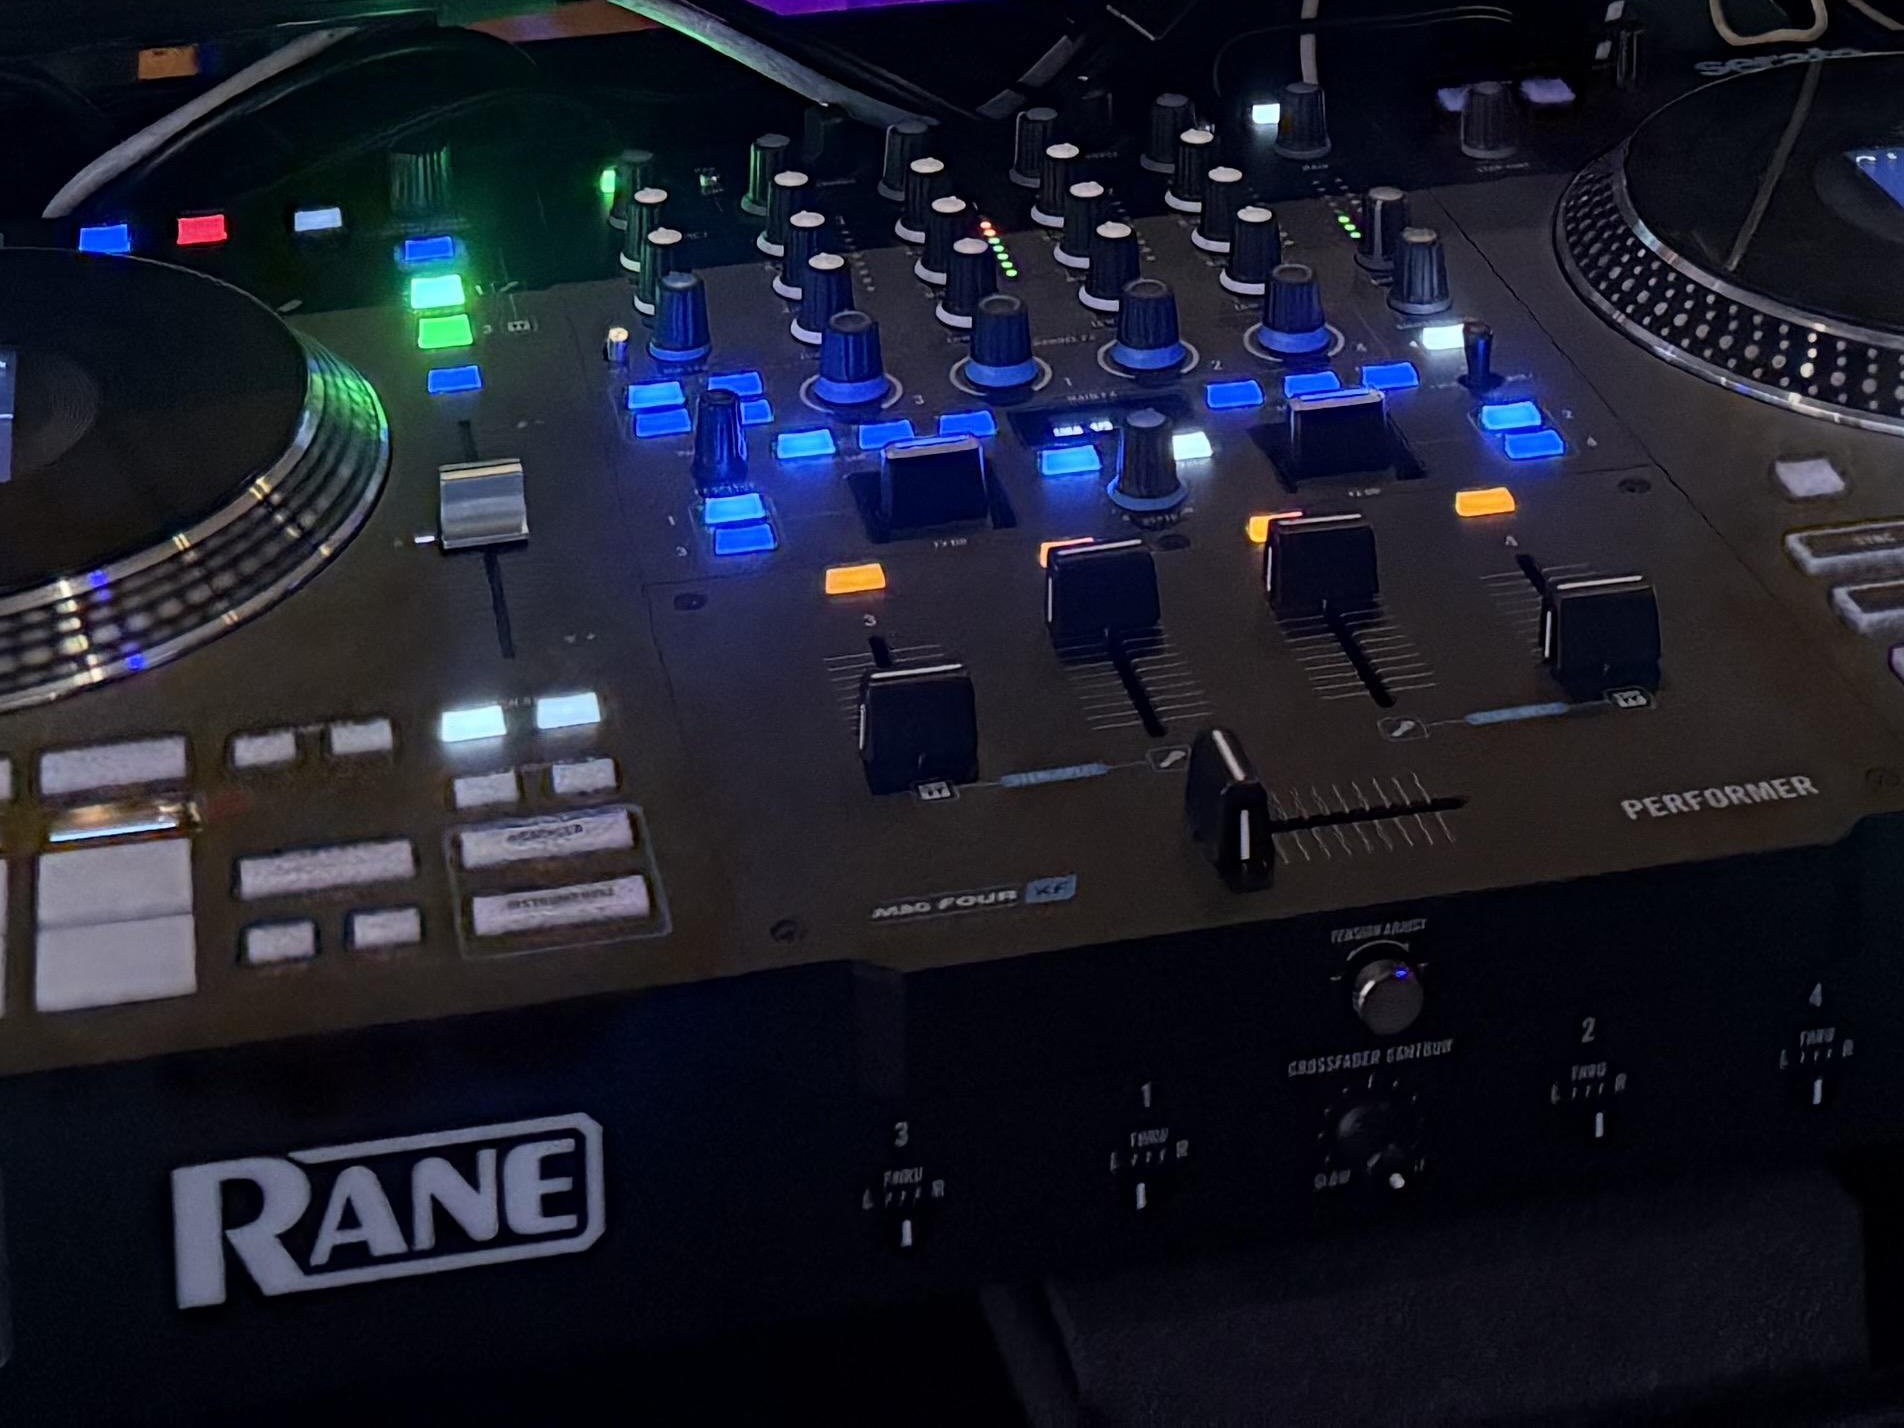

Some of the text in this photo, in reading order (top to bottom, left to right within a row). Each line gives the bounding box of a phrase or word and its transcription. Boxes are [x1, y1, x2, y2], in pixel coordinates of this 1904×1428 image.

[1620, 775, 1820, 821] PERFORMER
[938, 890, 1018, 910] FOUR
[1581, 1016, 1596, 1044] 2
[1288, 1048, 1381, 1078] CROSSFADER
[1140, 1081, 1152, 1108] 1
[894, 1121, 908, 1148] 3
[171, 1138, 578, 1310] RANE
